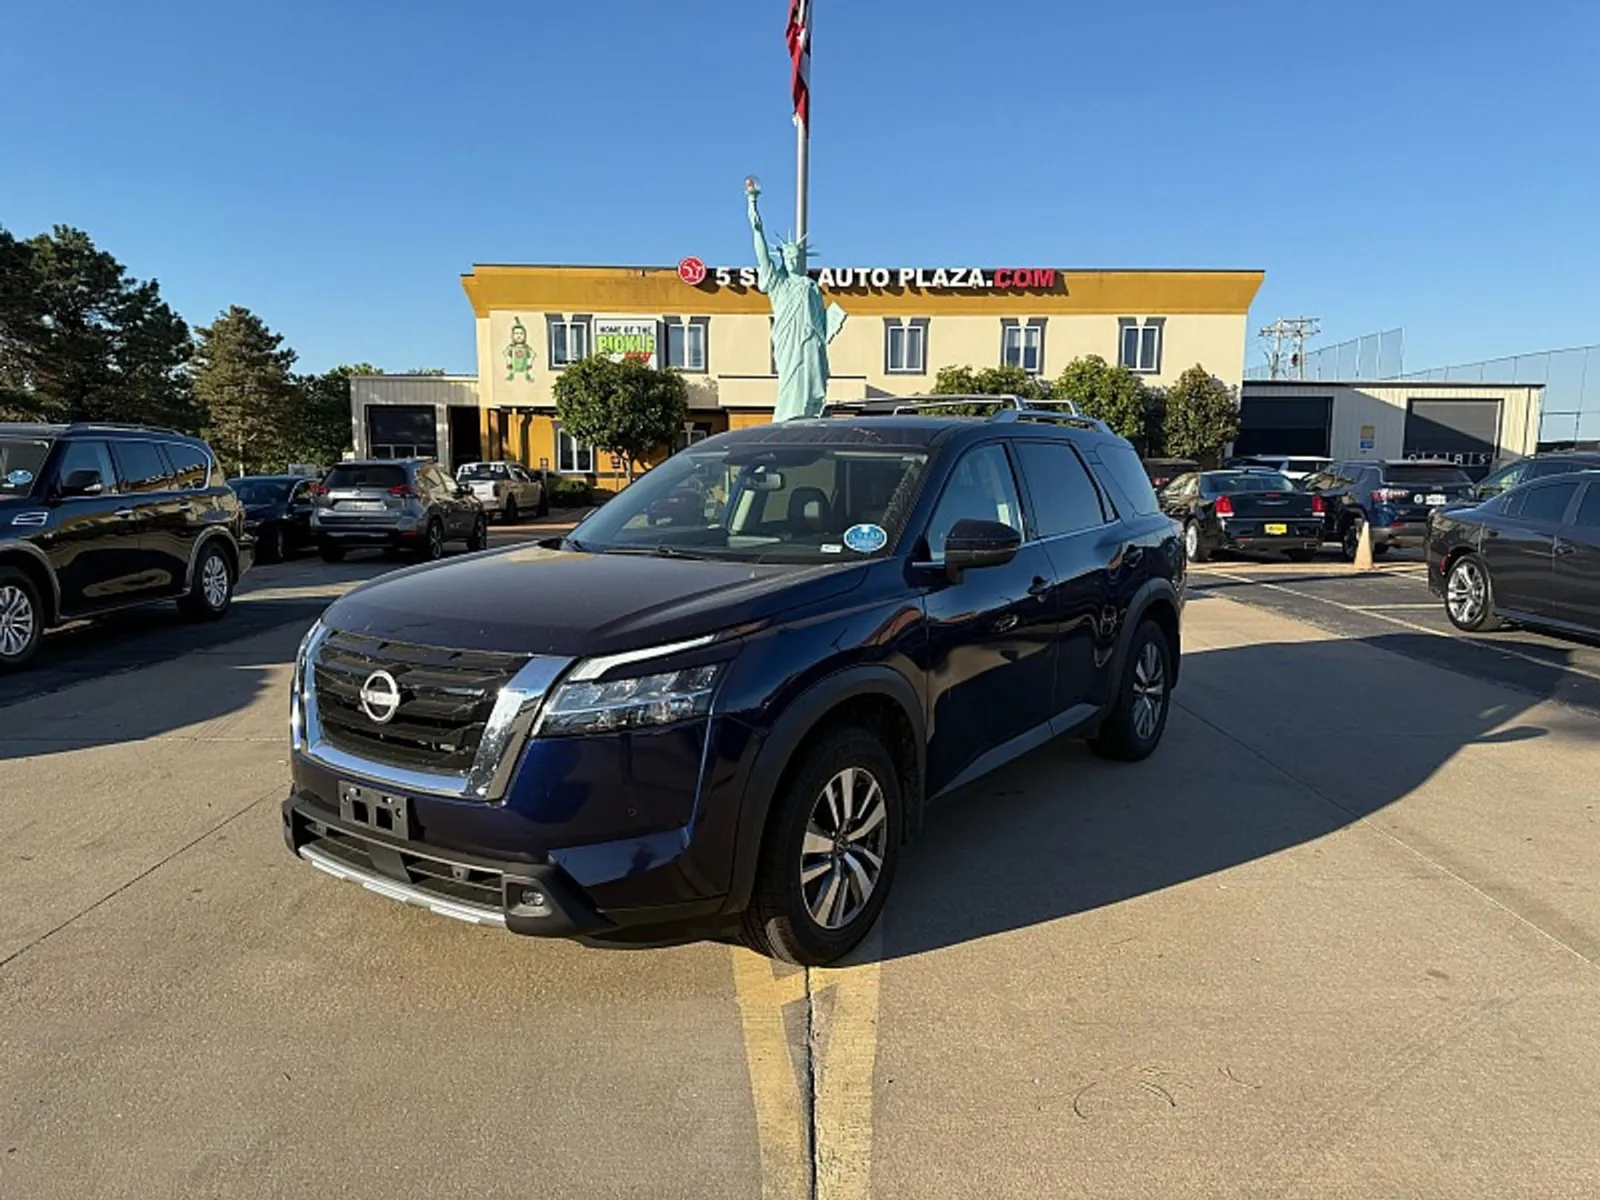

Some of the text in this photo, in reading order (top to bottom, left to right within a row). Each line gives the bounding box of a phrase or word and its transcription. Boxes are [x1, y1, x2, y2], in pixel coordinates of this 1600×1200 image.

[716, 267, 731, 287] 5
[818, 267, 890, 288] AUTO
[898, 267, 1056, 288] PLAZA.COM
